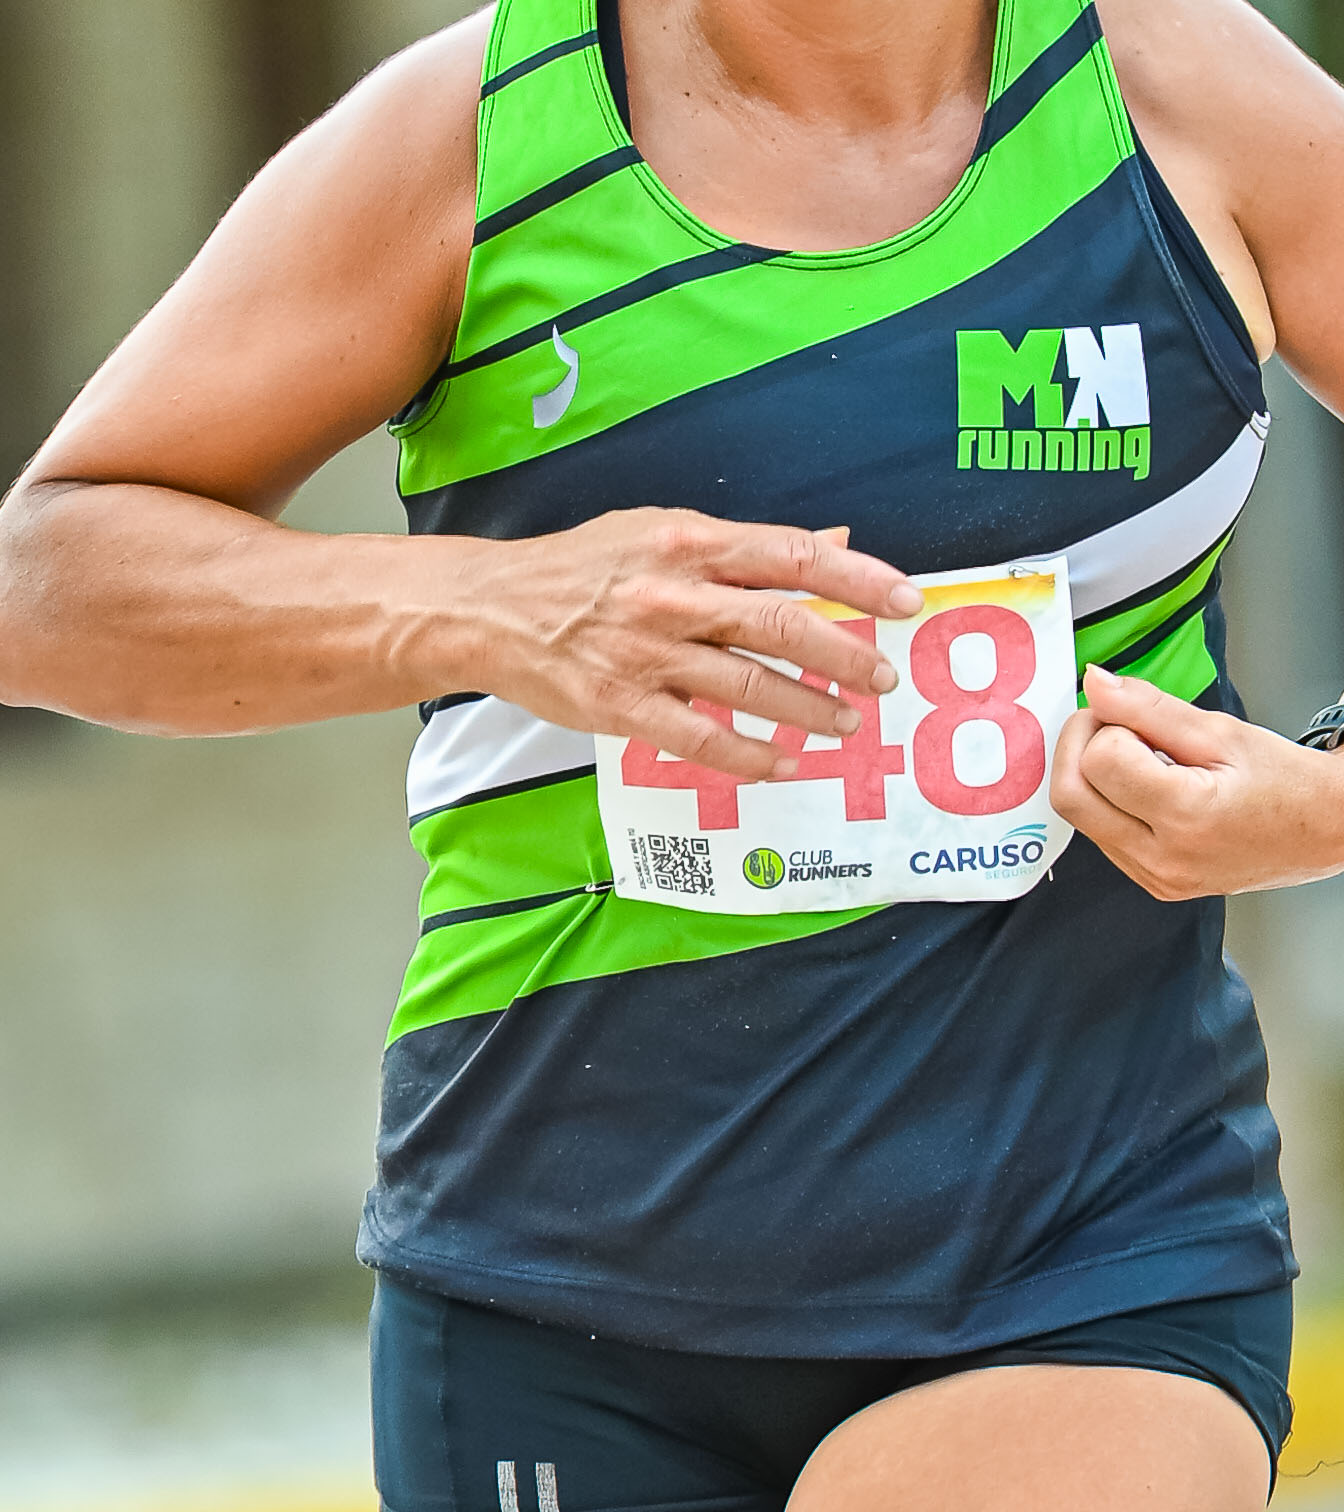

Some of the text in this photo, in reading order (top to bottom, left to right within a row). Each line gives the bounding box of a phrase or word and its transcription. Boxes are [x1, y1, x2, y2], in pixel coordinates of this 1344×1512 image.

[955, 322, 1151, 428] MN
[956, 419, 1151, 481] running
[788, 863, 873, 883] RUNNER'S
[789, 849, 833, 866] CLUB
[909, 840, 1044, 875] CARUSO
